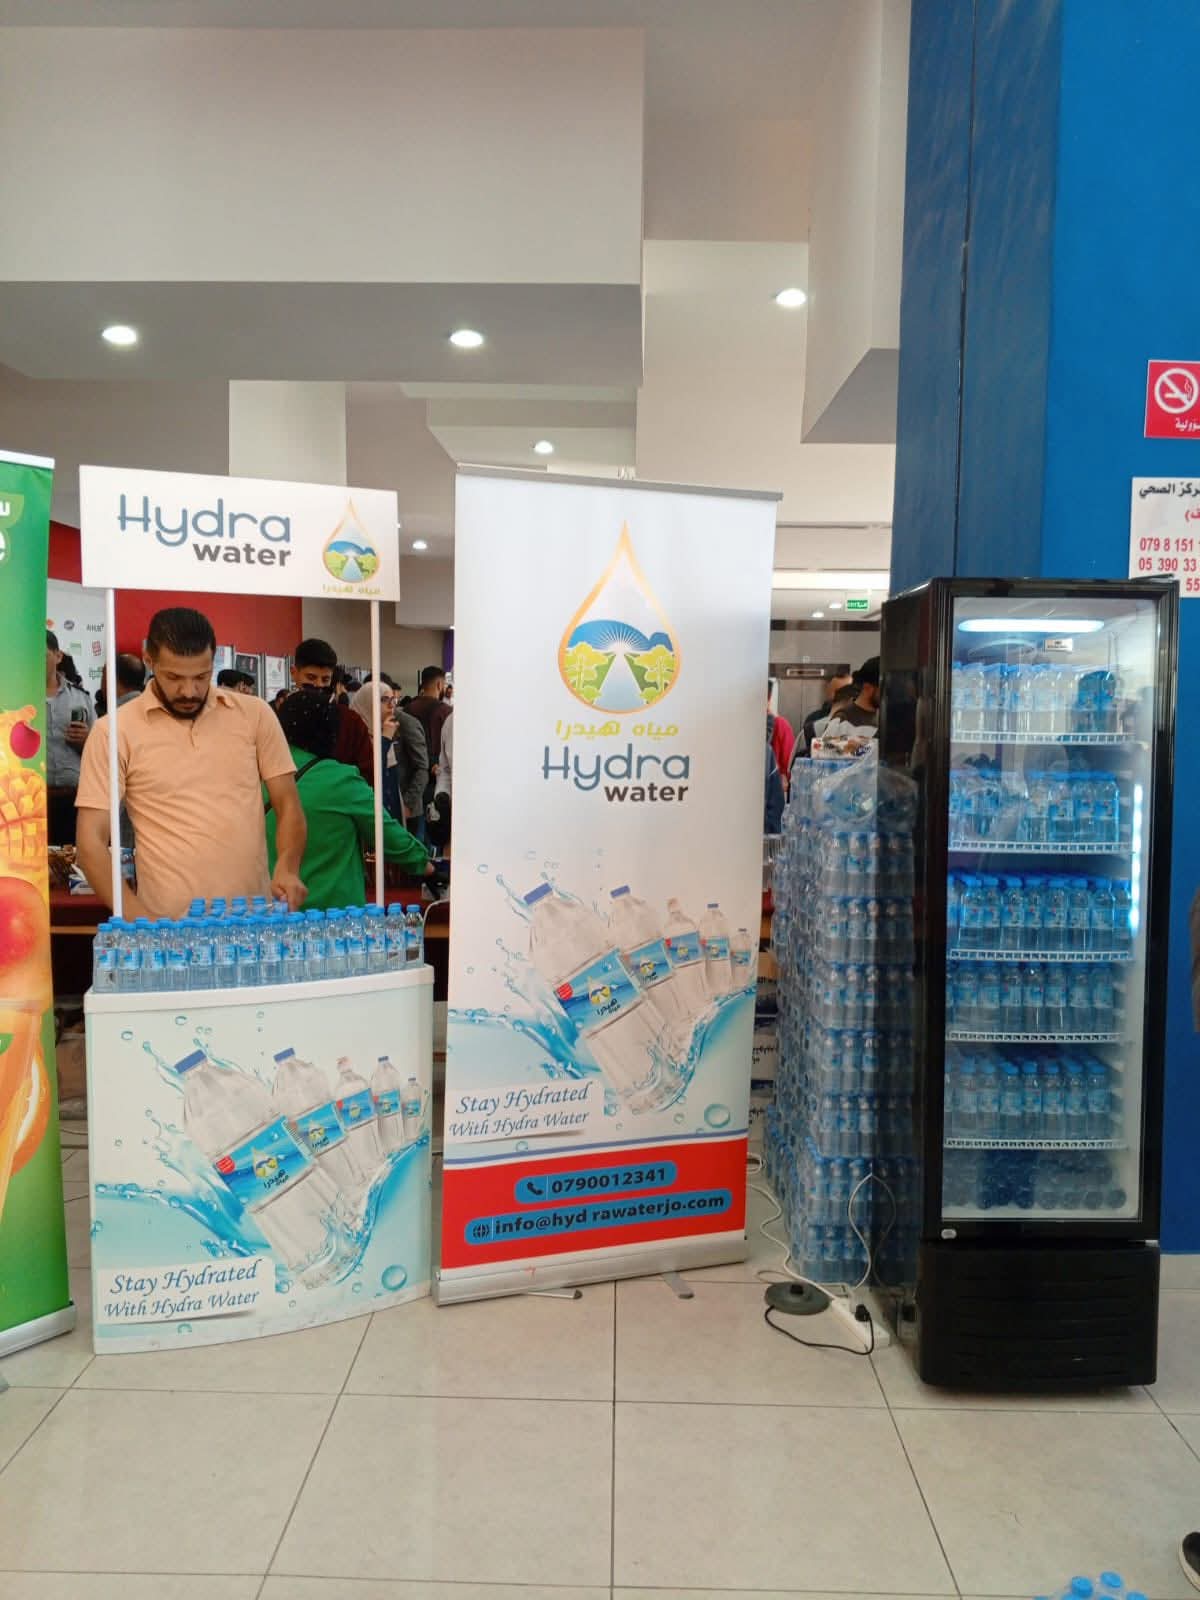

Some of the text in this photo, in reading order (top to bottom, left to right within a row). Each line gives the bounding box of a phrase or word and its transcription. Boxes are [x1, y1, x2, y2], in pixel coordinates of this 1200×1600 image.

[1139, 482, 1200, 499] ركز الصحي
[117, 493, 291, 547] Hydra
[192, 542, 291, 567] water
[1139, 537, 1160, 552] 079
[1163, 537, 1171, 552] 8
[1174, 537, 1194, 553] 151
[1138, 557, 1197, 572] 05 390 33
[556, 719, 679, 741] مياه هيدرا
[542, 743, 690, 791] Hydra
[604, 782, 689, 802] water
[456, 1081, 593, 1116] Stay Hydrated
[449, 1110, 590, 1137] With Hydra Water
[551, 1167, 666, 1194] 0790012341
[110, 1258, 263, 1297] Stay Hydrated
[104, 1290, 260, 1320] With Hydra Water
